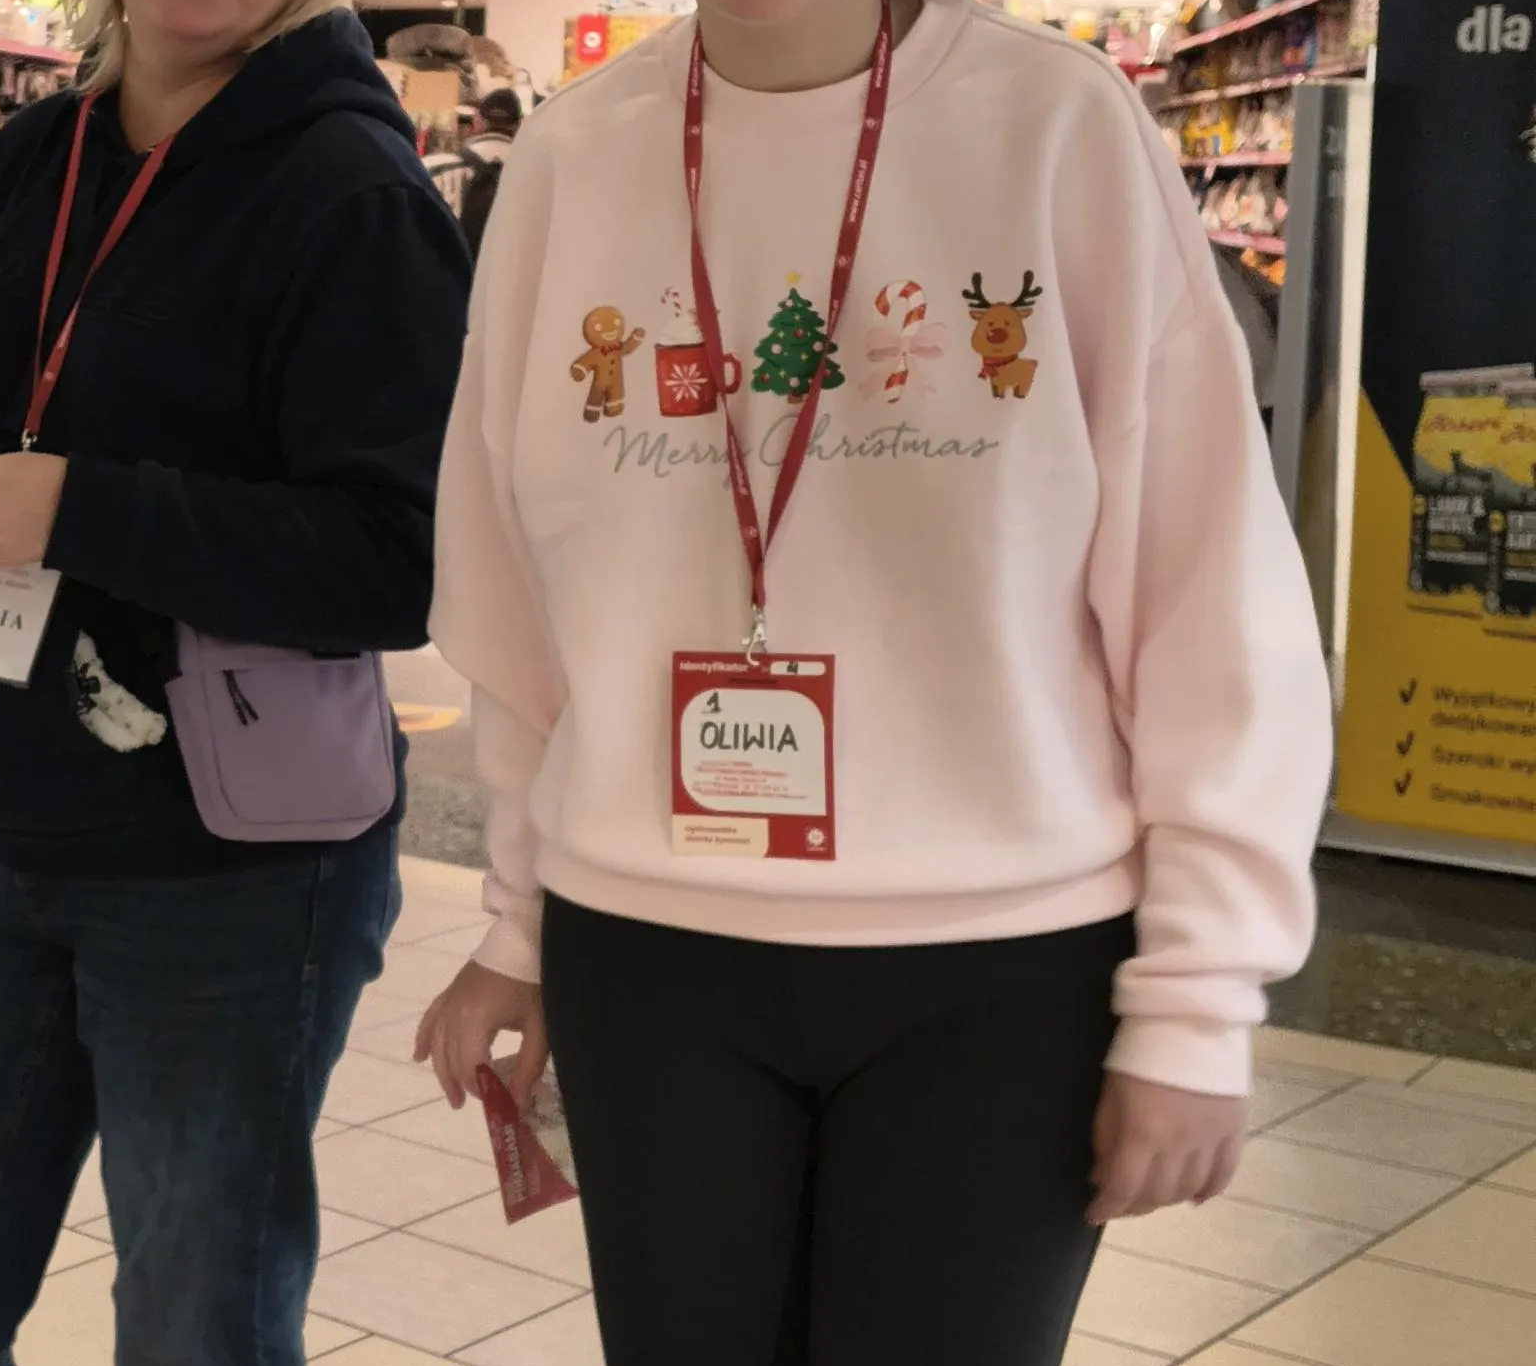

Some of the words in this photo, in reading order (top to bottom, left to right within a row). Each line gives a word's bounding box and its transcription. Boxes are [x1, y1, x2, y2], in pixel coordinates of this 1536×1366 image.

[1455, 3, 1533, 55] dla
[759, 413, 999, 469] Christmas
[699, 720, 799, 753] OLIWIA
